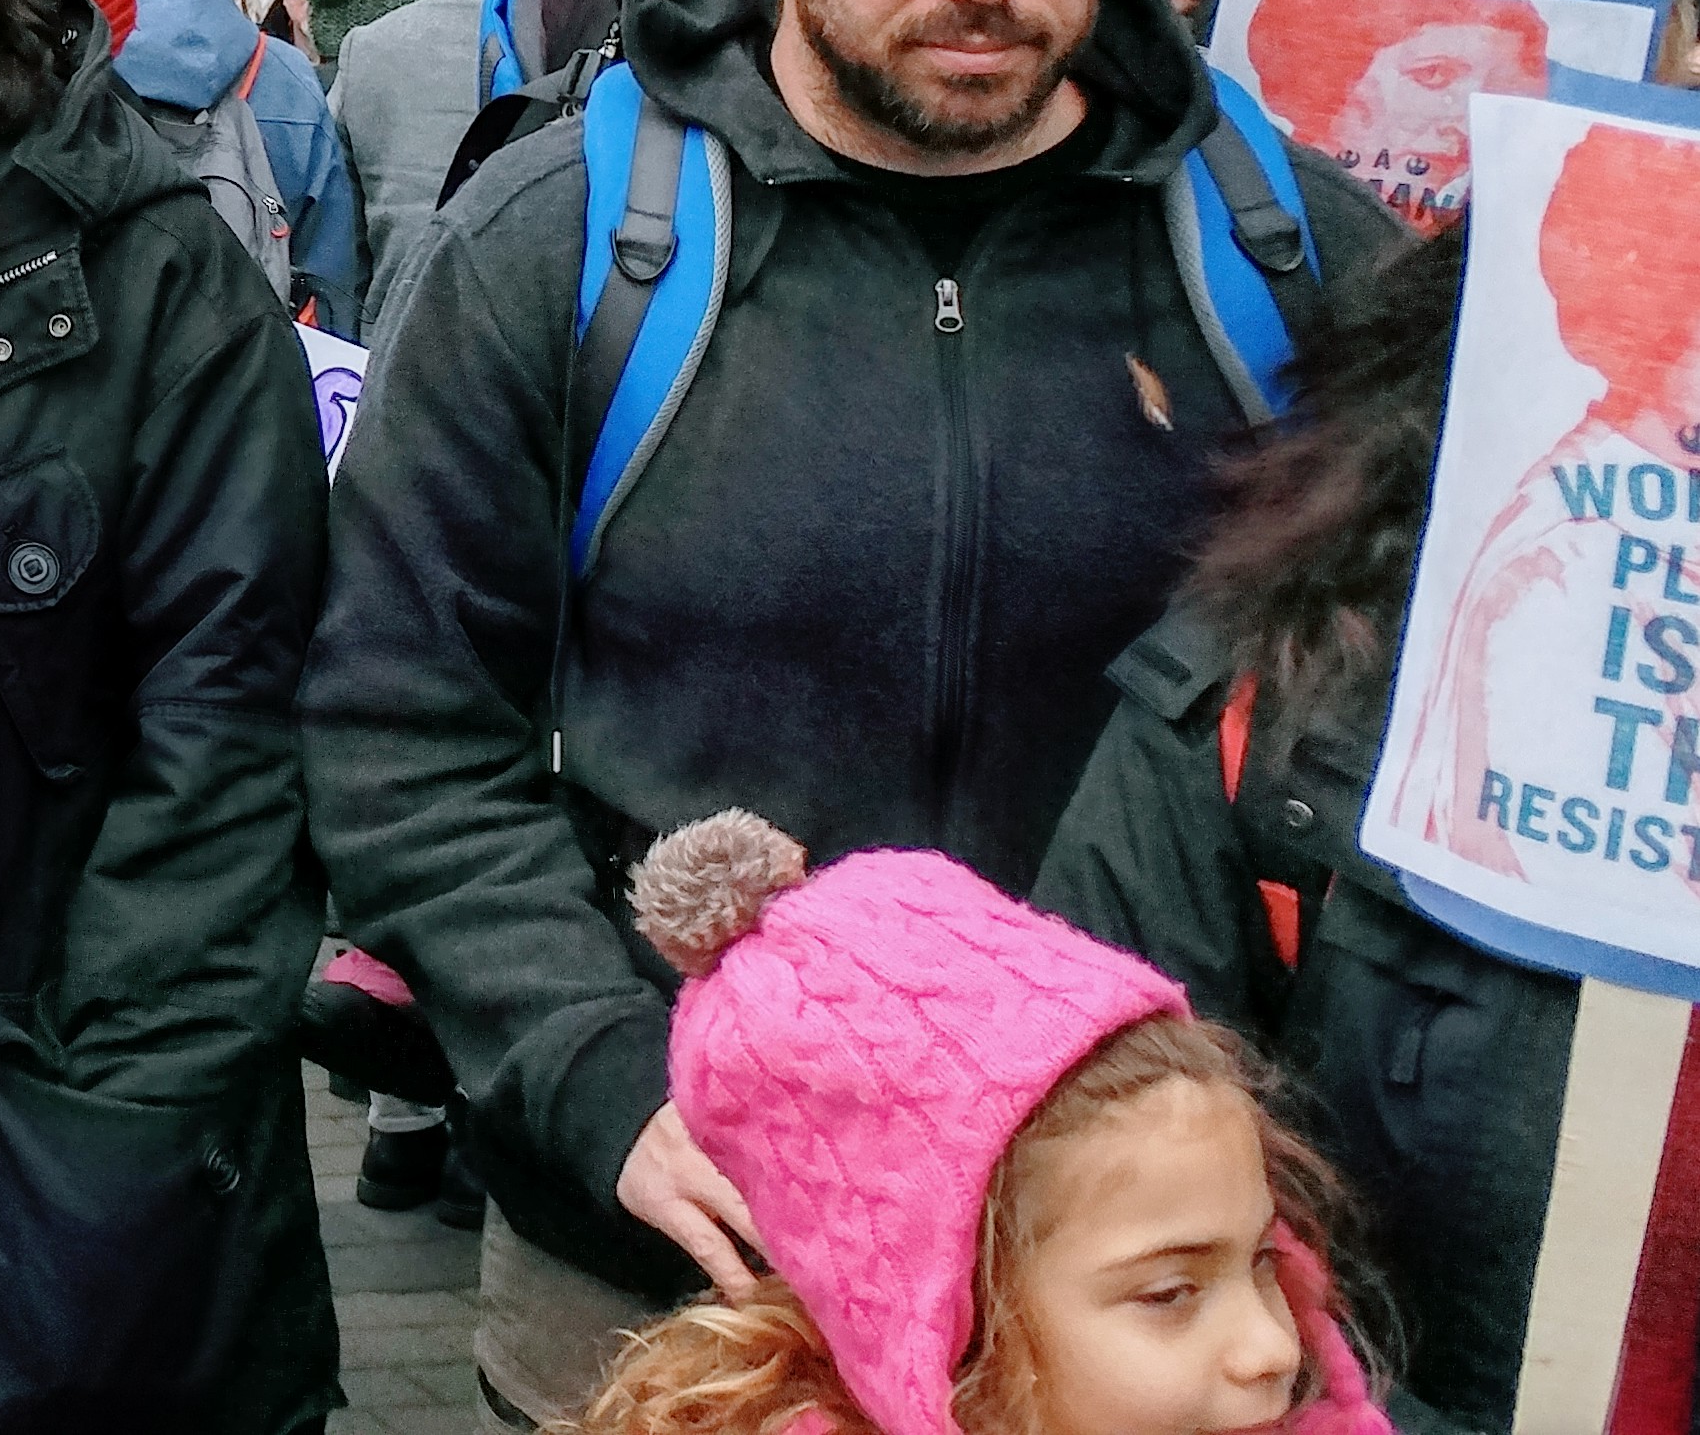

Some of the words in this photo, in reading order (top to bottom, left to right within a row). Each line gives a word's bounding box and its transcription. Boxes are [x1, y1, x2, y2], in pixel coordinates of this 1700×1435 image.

[1374, 148, 1390, 170] A
[1551, 462, 1700, 523] WO
[1601, 605, 1700, 696] IS
